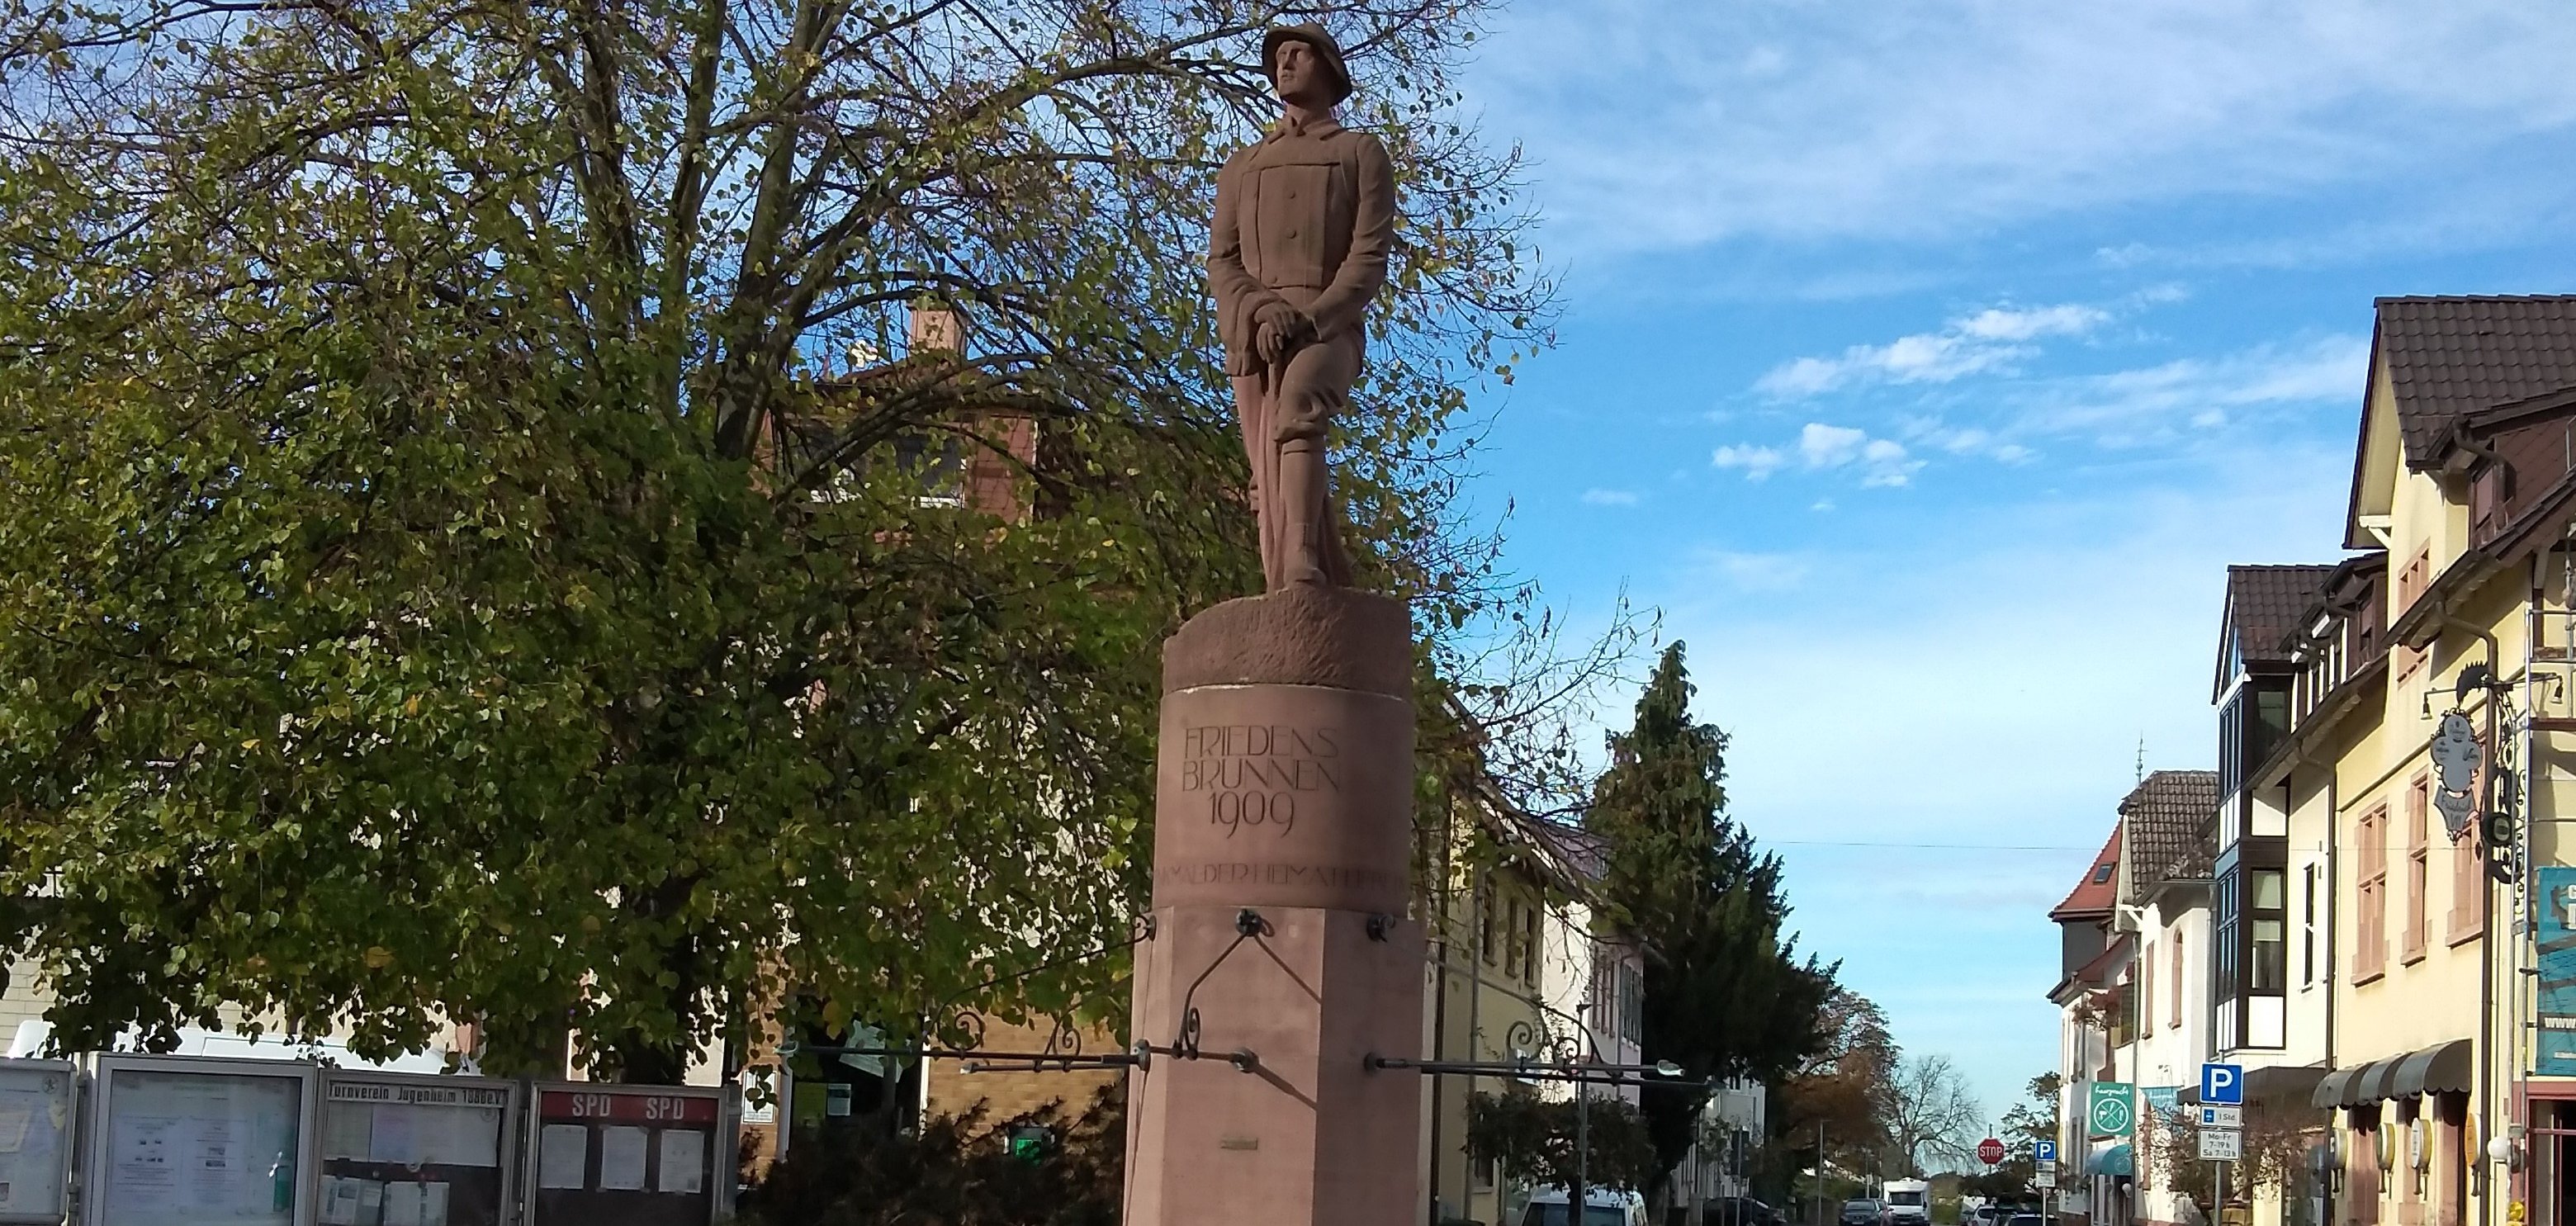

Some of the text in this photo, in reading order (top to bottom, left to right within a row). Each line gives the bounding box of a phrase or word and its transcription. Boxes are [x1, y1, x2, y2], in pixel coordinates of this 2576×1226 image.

[1185, 725, 1338, 759] FRIEDENS
[1182, 758, 1340, 793] BRUNNEN
[1207, 790, 1295, 840] 1909
[329, 1084, 389, 1100] Turnverein
[397, 1086, 457, 1105] Jugenheim
[2209, 1068, 2233, 1098] P
[572, 1094, 685, 1120] SPD SPD
[1980, 1146, 2003, 1157] STOP
[2039, 1143, 2052, 1158] P
